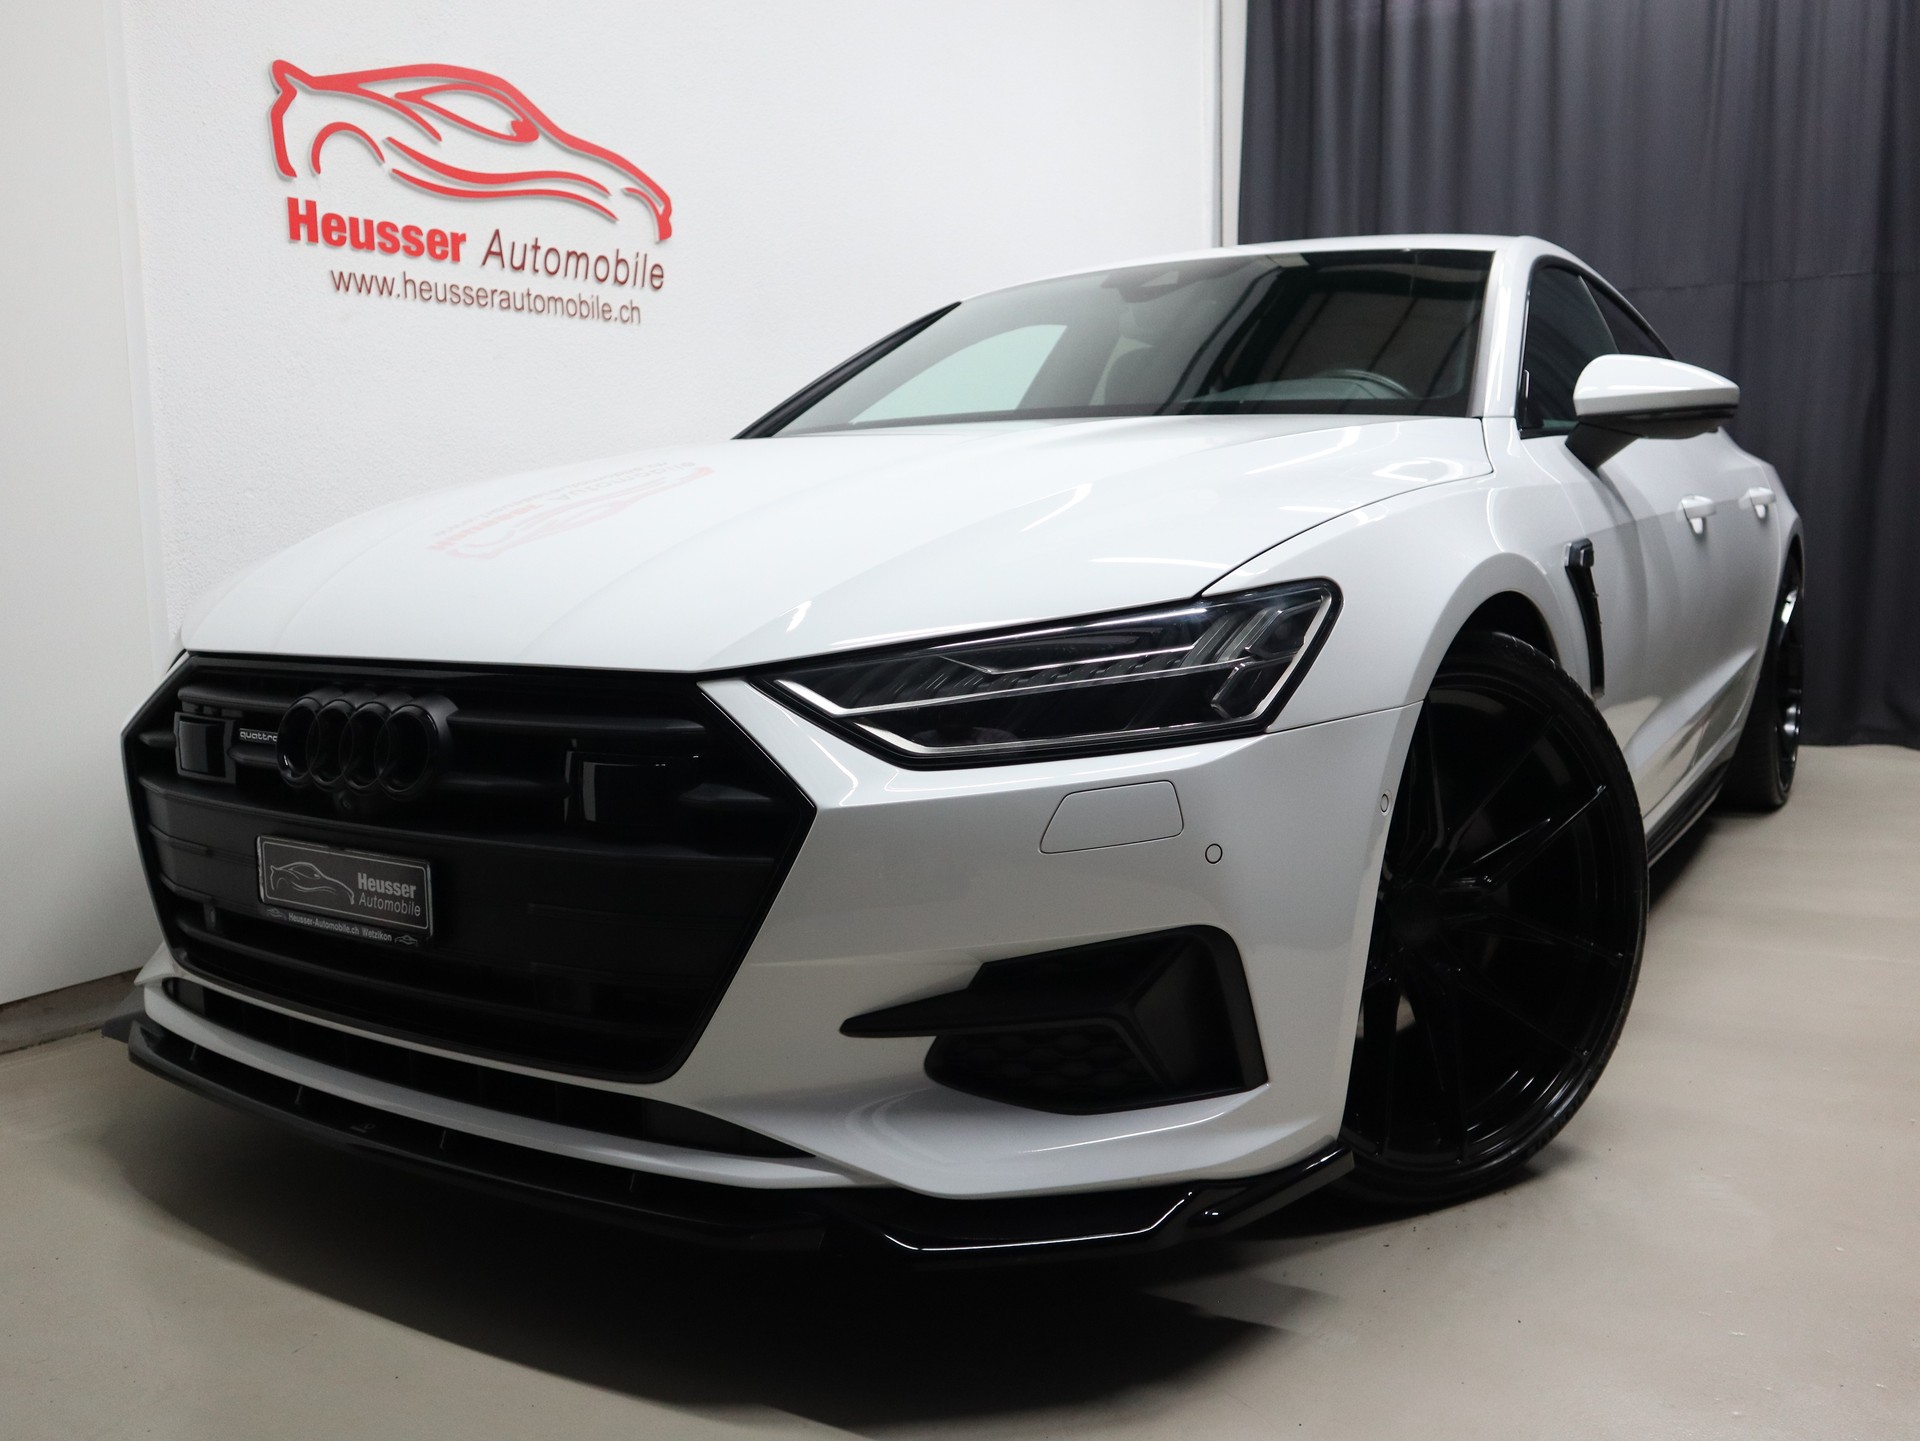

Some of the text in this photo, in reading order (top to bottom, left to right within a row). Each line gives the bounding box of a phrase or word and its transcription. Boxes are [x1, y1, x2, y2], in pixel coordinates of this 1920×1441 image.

[287, 197, 664, 290] Heusser Automobile
[330, 269, 641, 325] www.heusserautomobile.ch
[357, 873, 417, 898] Heusser
[359, 893, 421, 917] Automobile
[288, 912, 393, 942] Heusser-Automobile.ch Wetzikon
